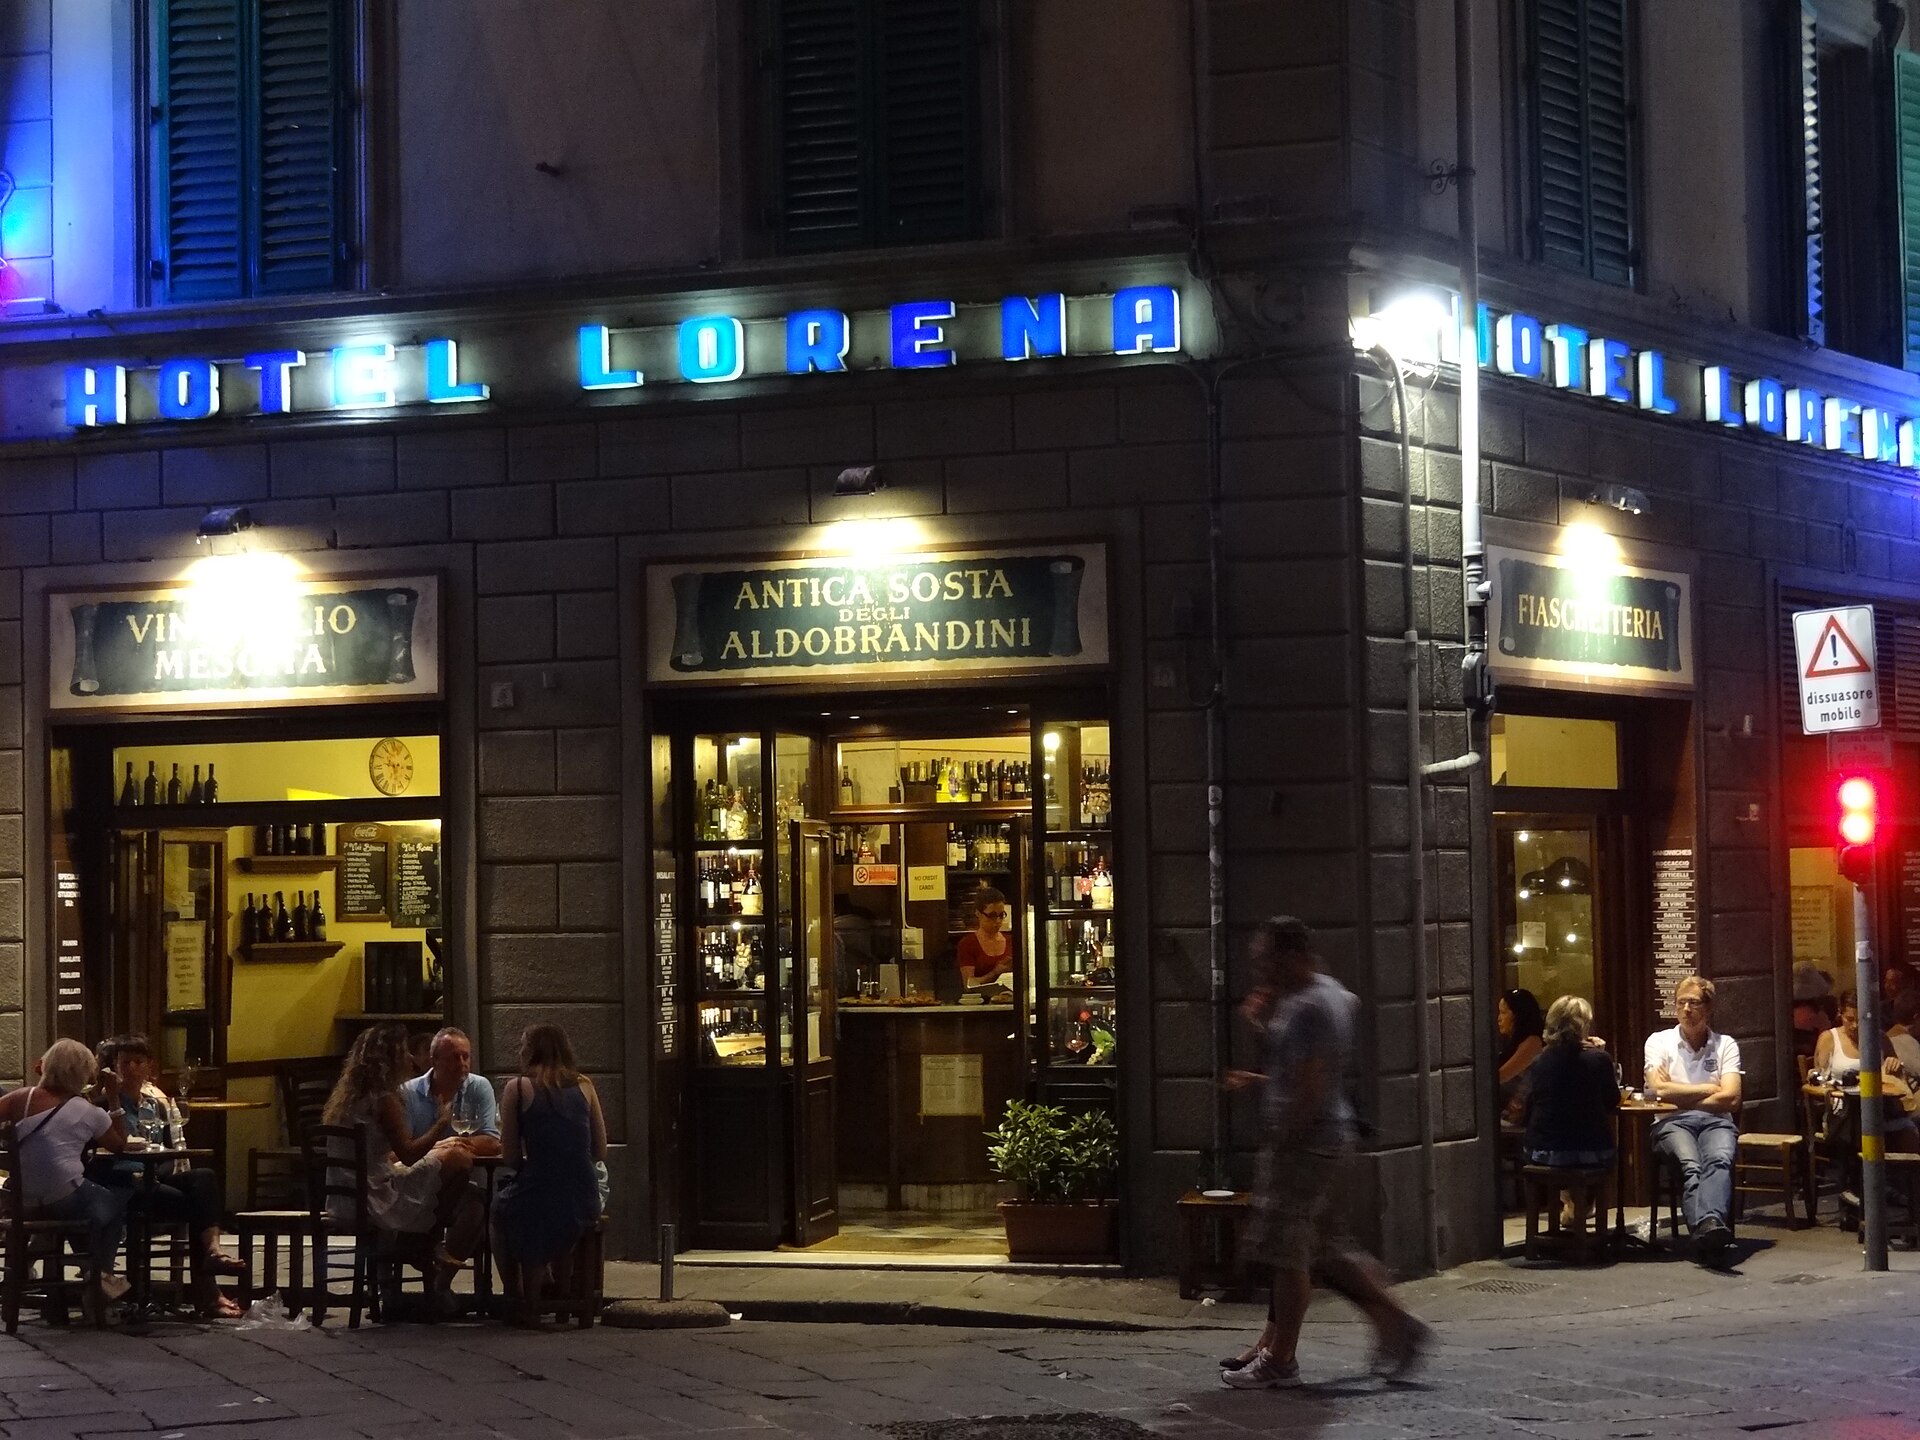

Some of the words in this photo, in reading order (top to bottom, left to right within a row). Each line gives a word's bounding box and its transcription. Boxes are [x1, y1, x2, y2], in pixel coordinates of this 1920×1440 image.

[66, 338, 490, 427] HOTEL
[578, 285, 1182, 390] LORENA
[734, 574, 875, 610] ANTICA
[888, 569, 1014, 603] SOSTA
[839, 606, 911, 622] DEGLI
[720, 617, 1032, 660] ALDOBRANDINI
[1806, 688, 1873, 705] dissuasore
[1820, 707, 1861, 723] mobile
[656, 871, 676, 880] INSALATE
